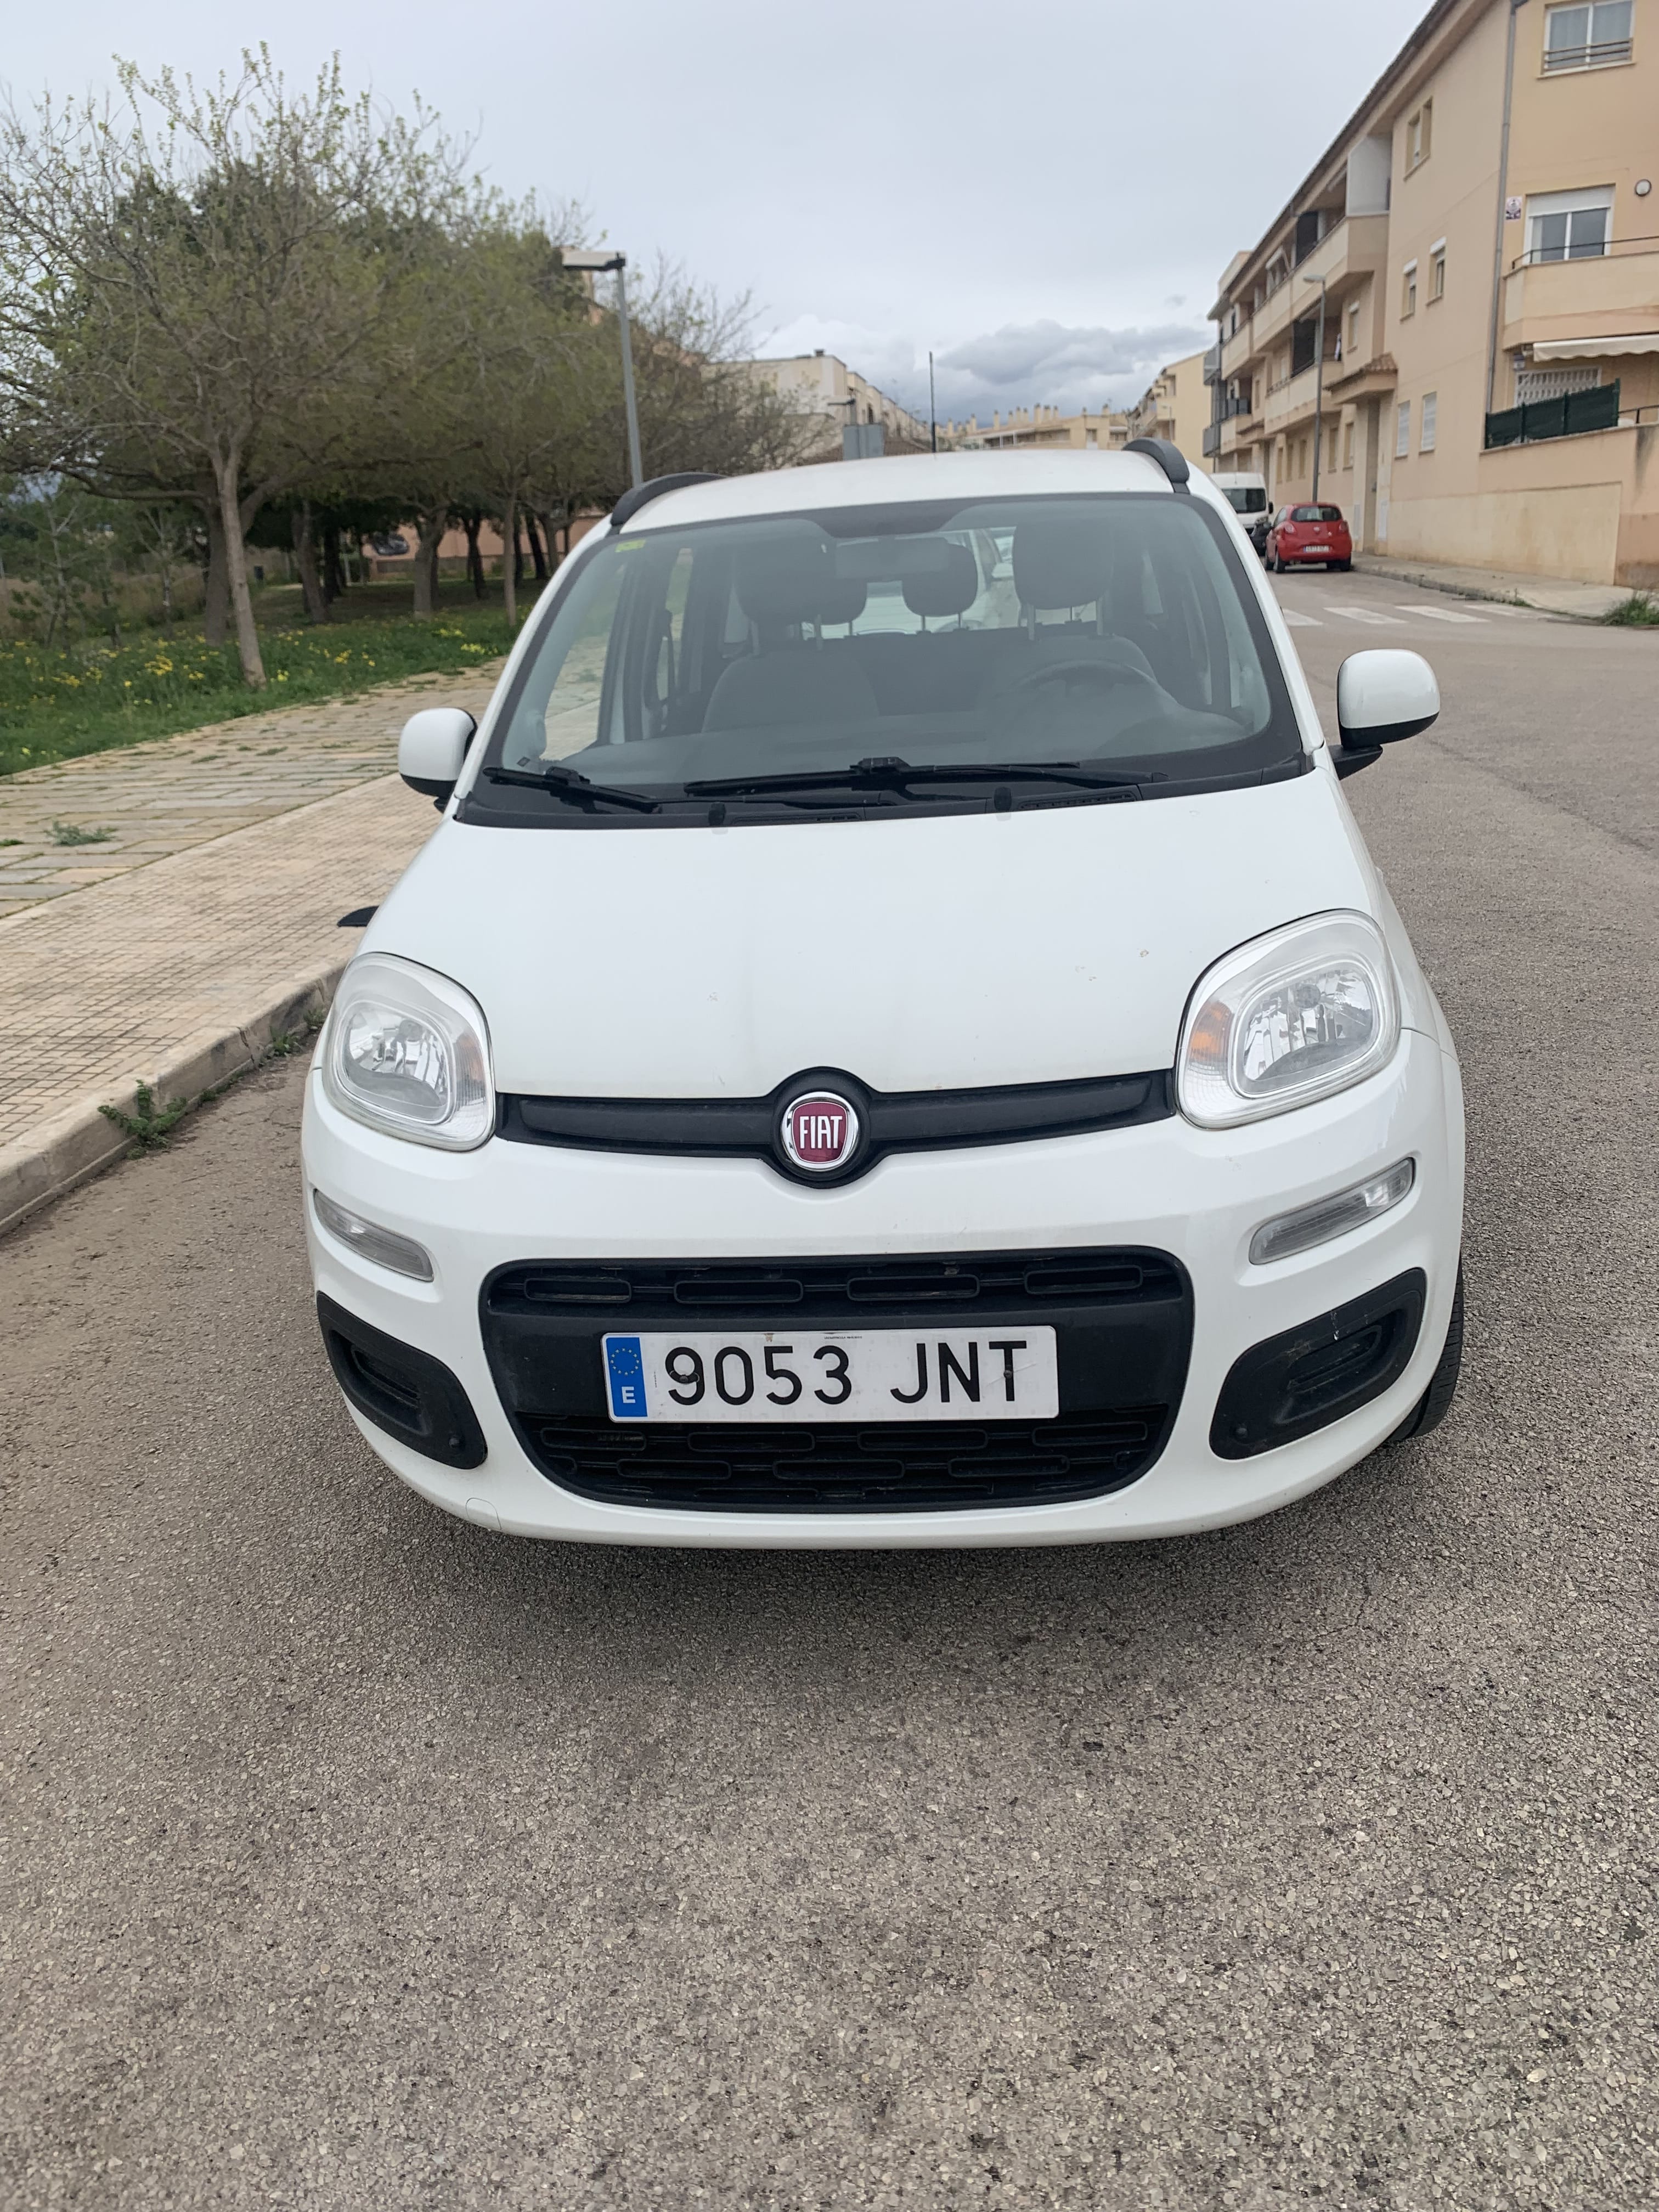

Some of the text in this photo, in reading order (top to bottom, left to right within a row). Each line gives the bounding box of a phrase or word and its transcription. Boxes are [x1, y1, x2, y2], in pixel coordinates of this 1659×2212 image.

[799, 1116, 843, 1149] FIAT
[665, 1340, 1027, 1406] 9053 JNT
[622, 1386, 636, 1403] E
